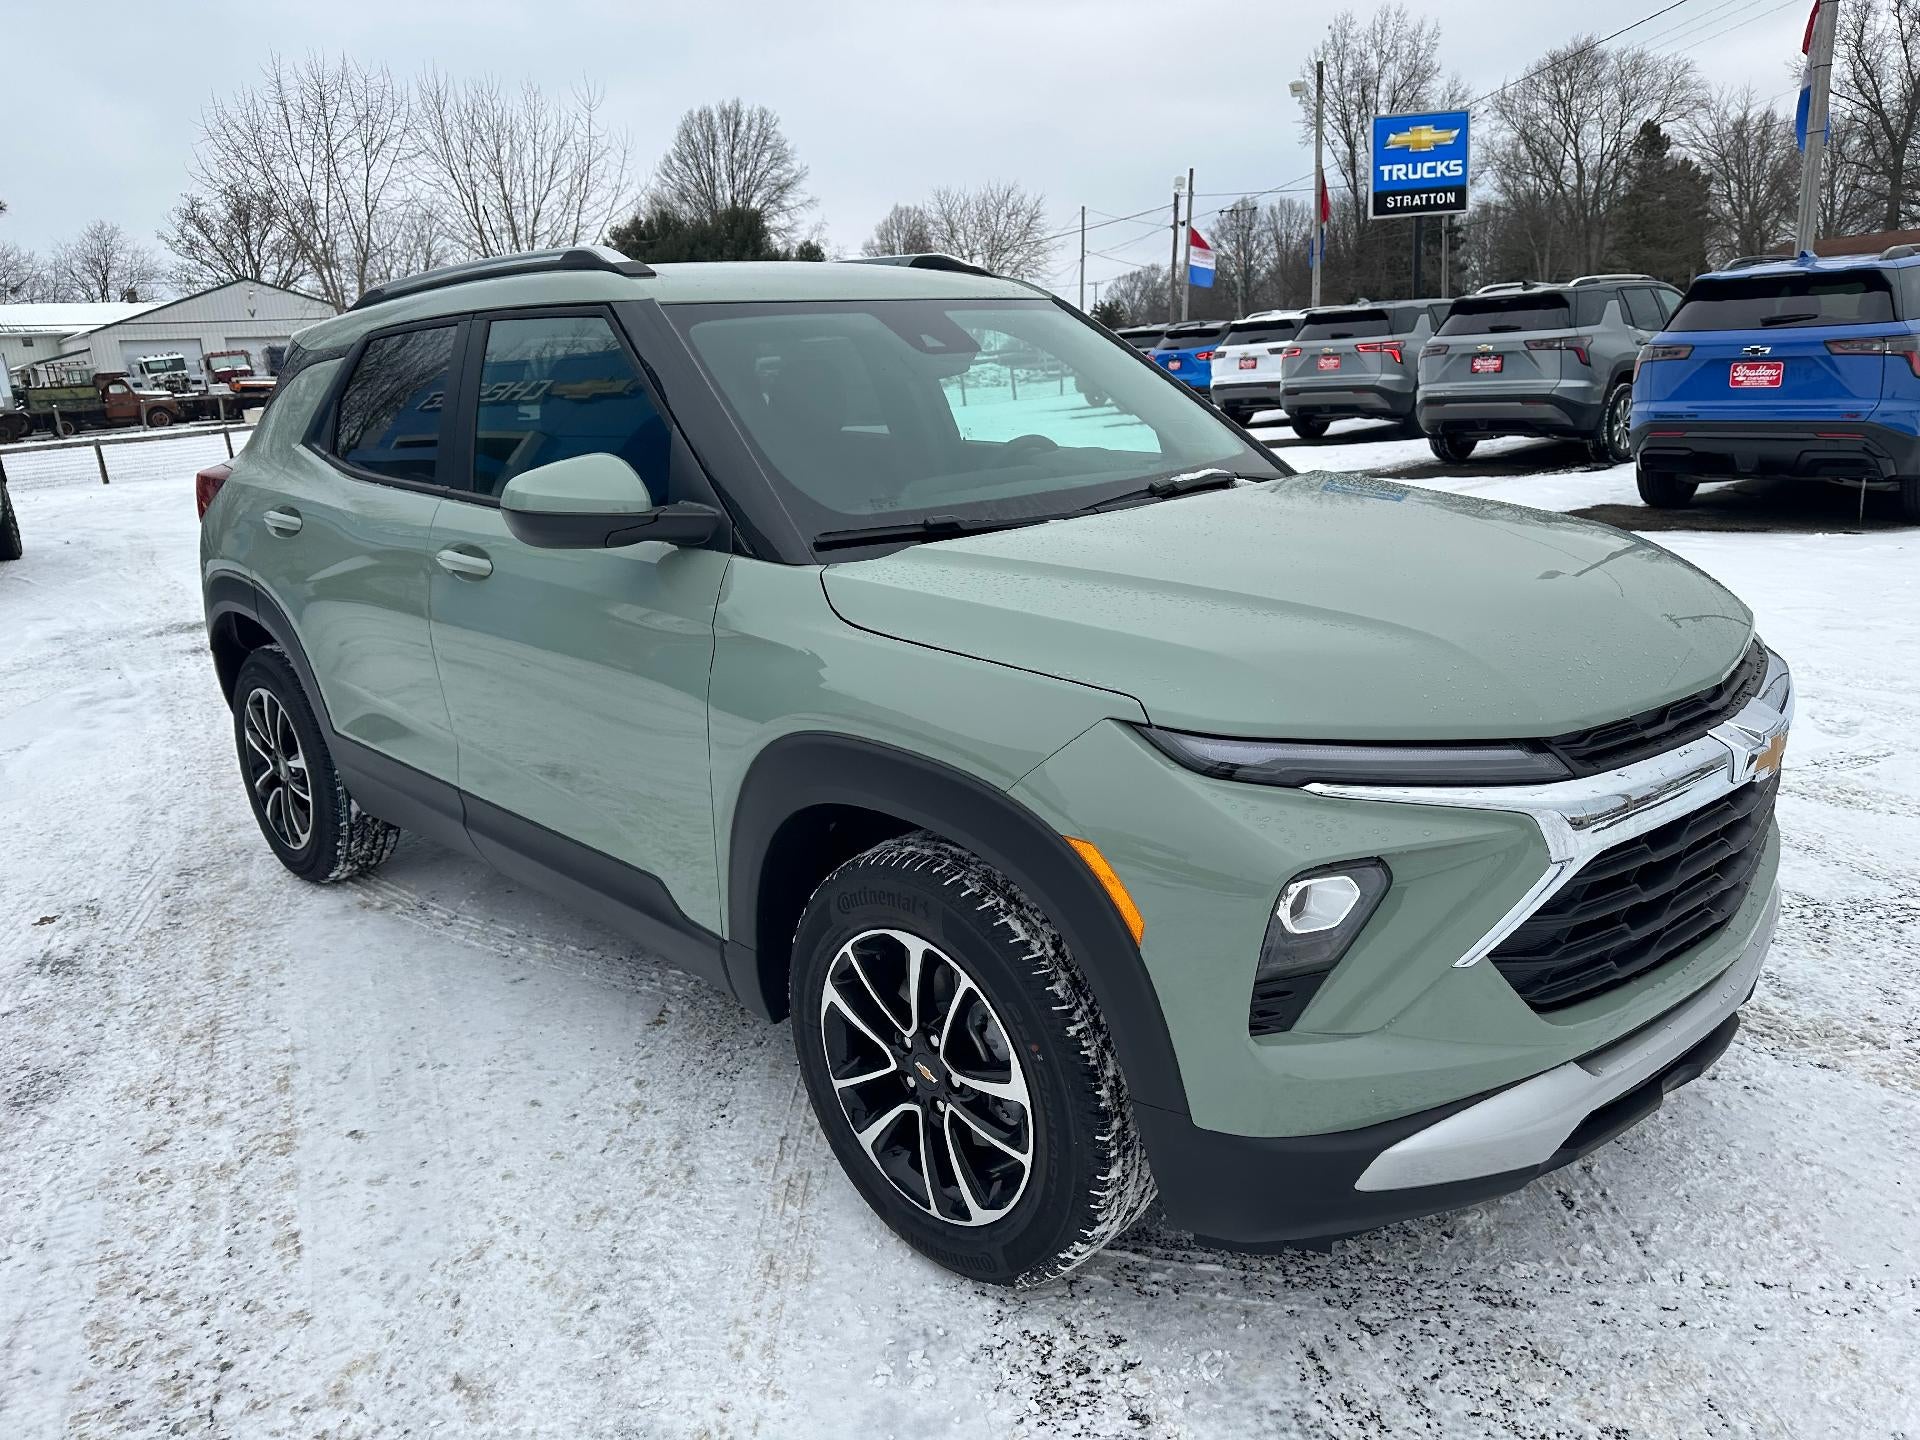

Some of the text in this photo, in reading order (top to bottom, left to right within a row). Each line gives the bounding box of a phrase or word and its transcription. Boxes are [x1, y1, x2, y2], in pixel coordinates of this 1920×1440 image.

[1380, 160, 1463, 181] TRUCKS
[1386, 192, 1456, 208] STRATTON
[1733, 365, 1780, 377] Stratton
[837, 886, 917, 915] Continental
